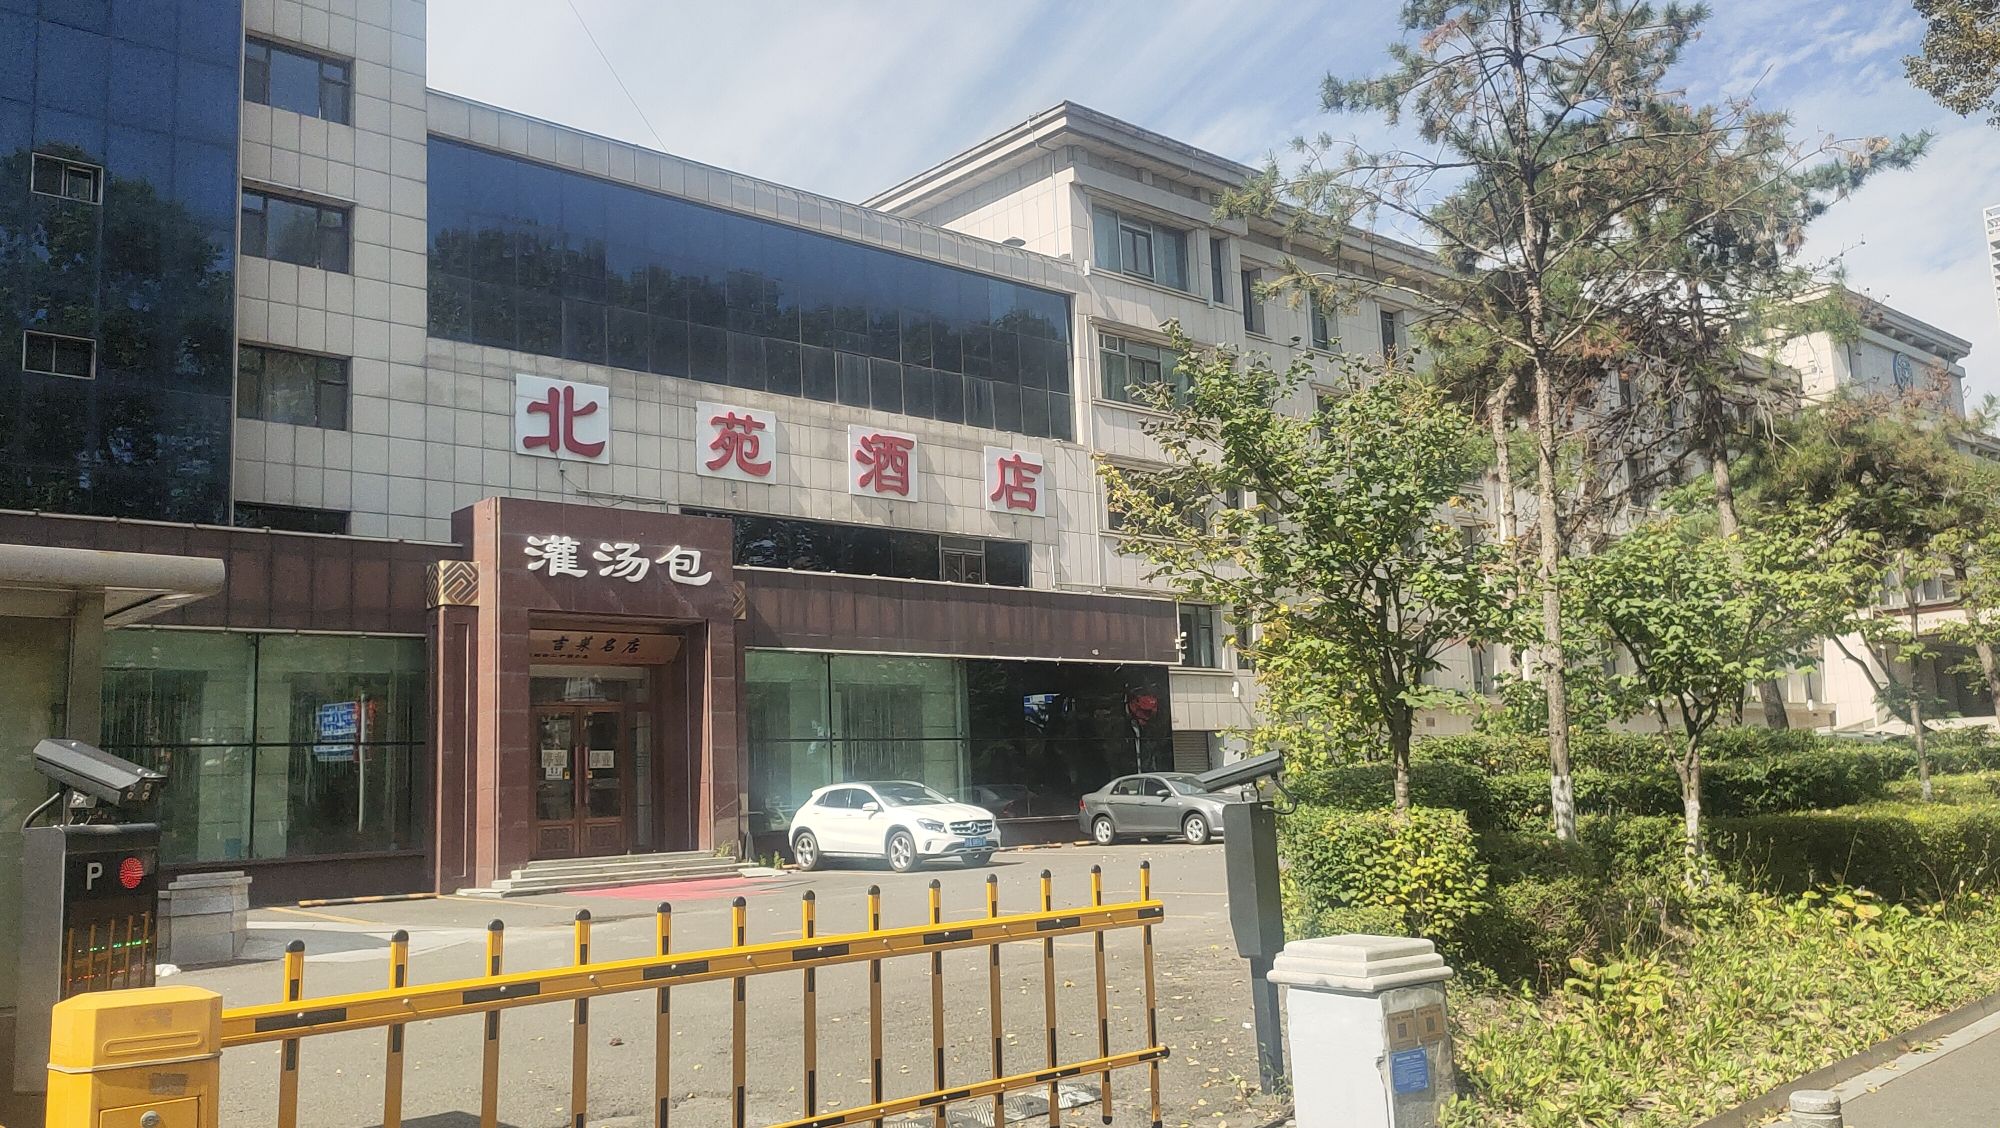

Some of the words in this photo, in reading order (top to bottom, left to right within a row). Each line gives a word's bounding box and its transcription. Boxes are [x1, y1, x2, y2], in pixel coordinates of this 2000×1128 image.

[522, 386, 1043, 512] 北苑酒店
[524, 535, 712, 586] 灌汤包
[86, 862, 103, 890] P
